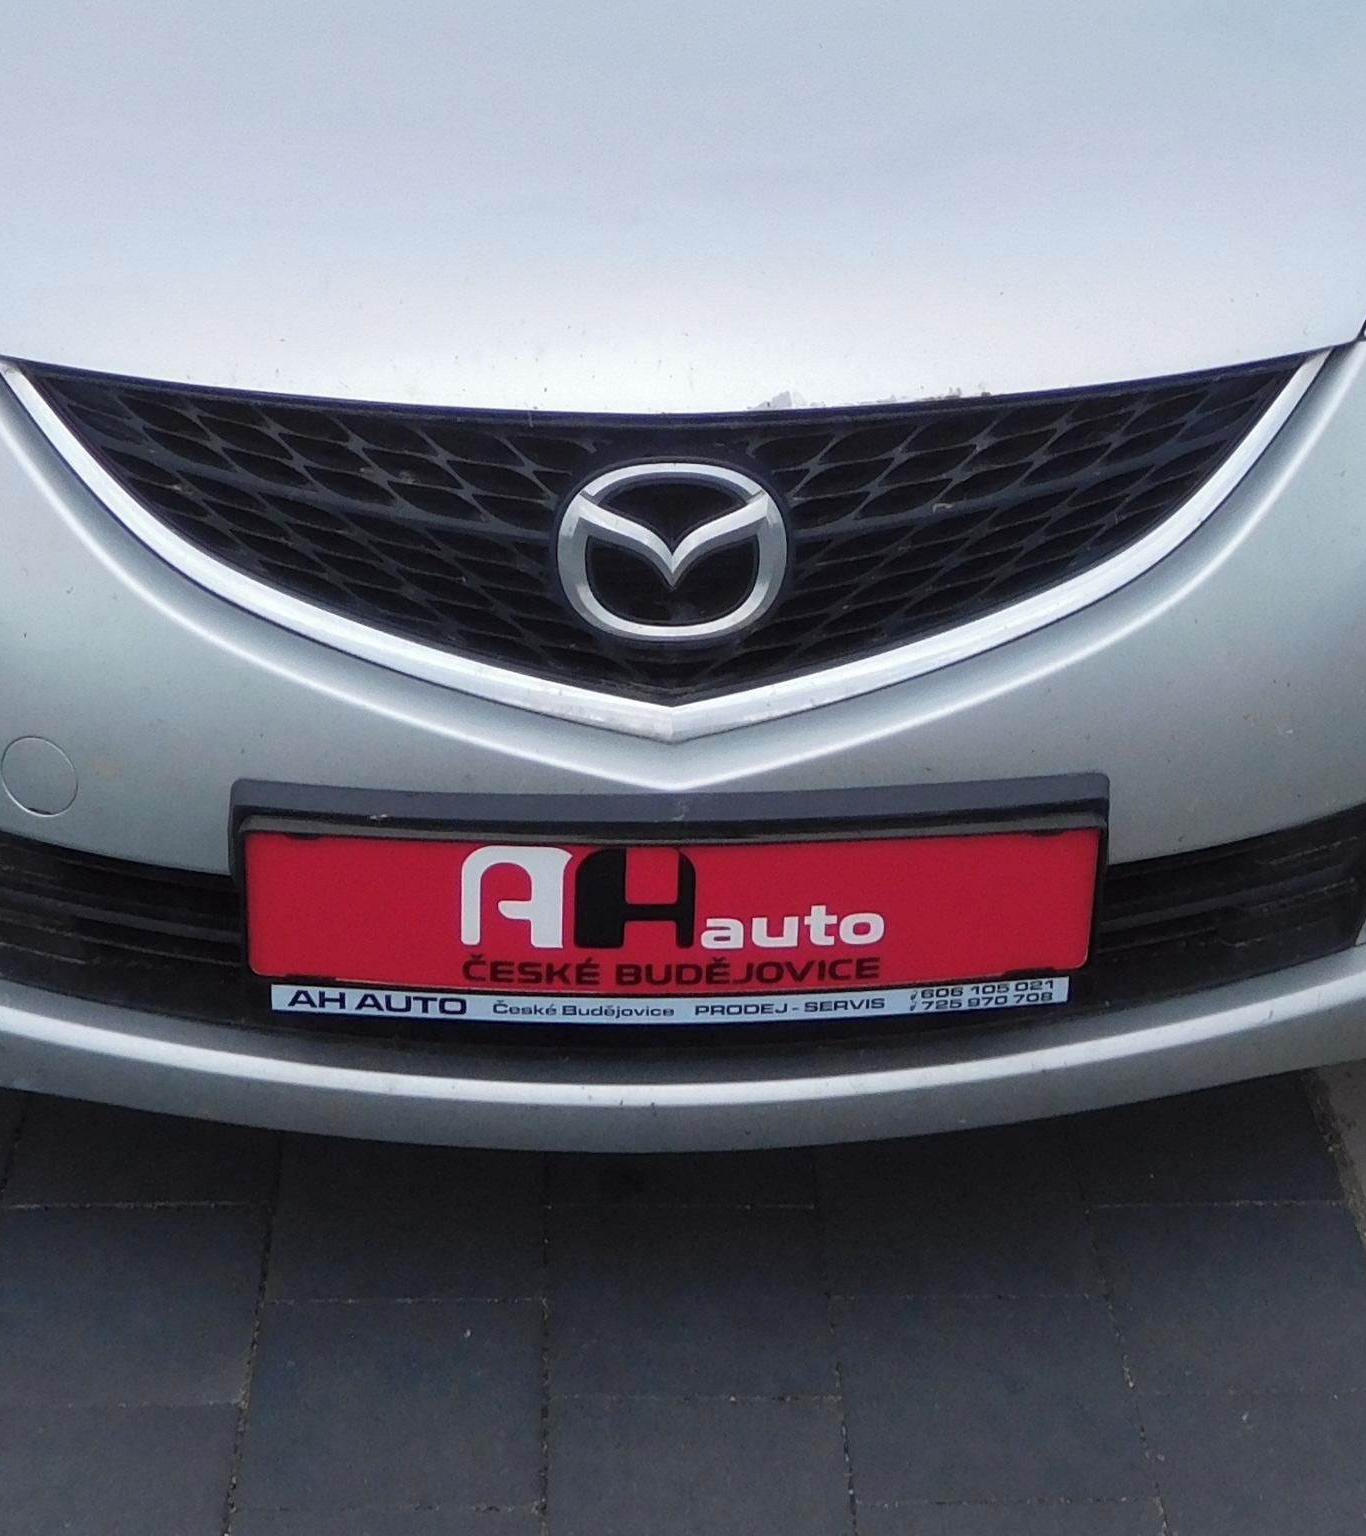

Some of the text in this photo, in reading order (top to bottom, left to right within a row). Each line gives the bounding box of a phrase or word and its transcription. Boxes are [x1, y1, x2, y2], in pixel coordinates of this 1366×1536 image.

[462, 953, 881, 987] ČESKÉ BUDĚJOVICE
[921, 979, 1054, 999] 606 105 021
[922, 991, 1053, 1011] 725 970 708
[288, 989, 347, 1011] AH
[354, 994, 468, 1016] AUTO
[492, 999, 557, 1016] České
[561, 1003, 675, 1019] Budějovice
[695, 1002, 787, 1017] PRODEJ
[803, 998, 886, 1013] SERVIS
